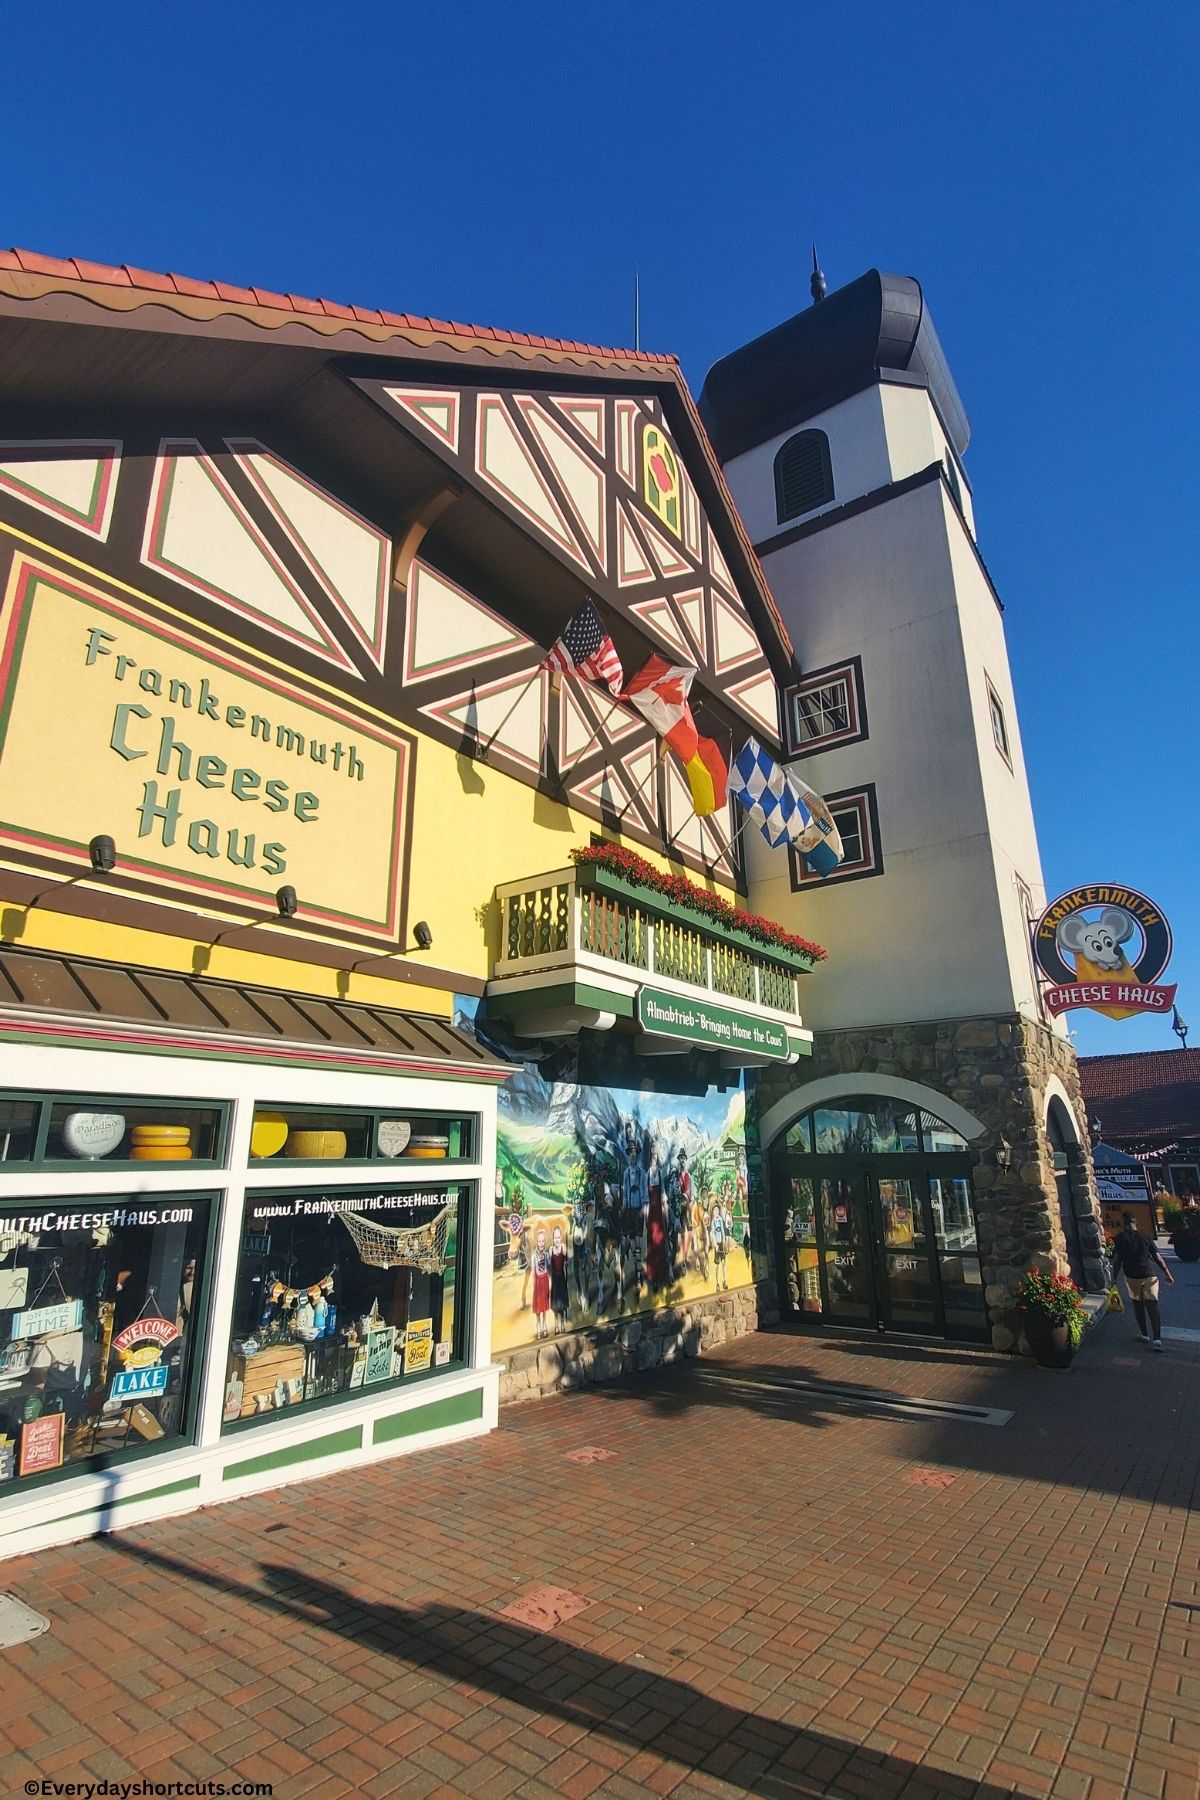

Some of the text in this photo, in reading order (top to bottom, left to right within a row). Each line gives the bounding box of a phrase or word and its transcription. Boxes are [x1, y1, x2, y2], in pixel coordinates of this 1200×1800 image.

[85, 627, 364, 781] Frankenmuth
[110, 704, 319, 822] Cheese
[136, 780, 287, 874] Haus
[1039, 888, 1160, 939] FRANKENMUTH
[1049, 985, 1166, 1007] CHEESE HAUS
[732, 1021, 752, 1040] Home
[754, 1028, 765, 1043] the
[1101, 1190, 1123, 1199] Haus
[835, 1257, 855, 1265] EXIT
[896, 1260, 918, 1269] EXIT
[27, 1306, 70, 1320] ON LAKE
[26, 1315, 68, 1335] TIME
[118, 1321, 173, 1345] WELCOME
[376, 1333, 386, 1342] GO
[117, 1369, 164, 1392] LAKE
